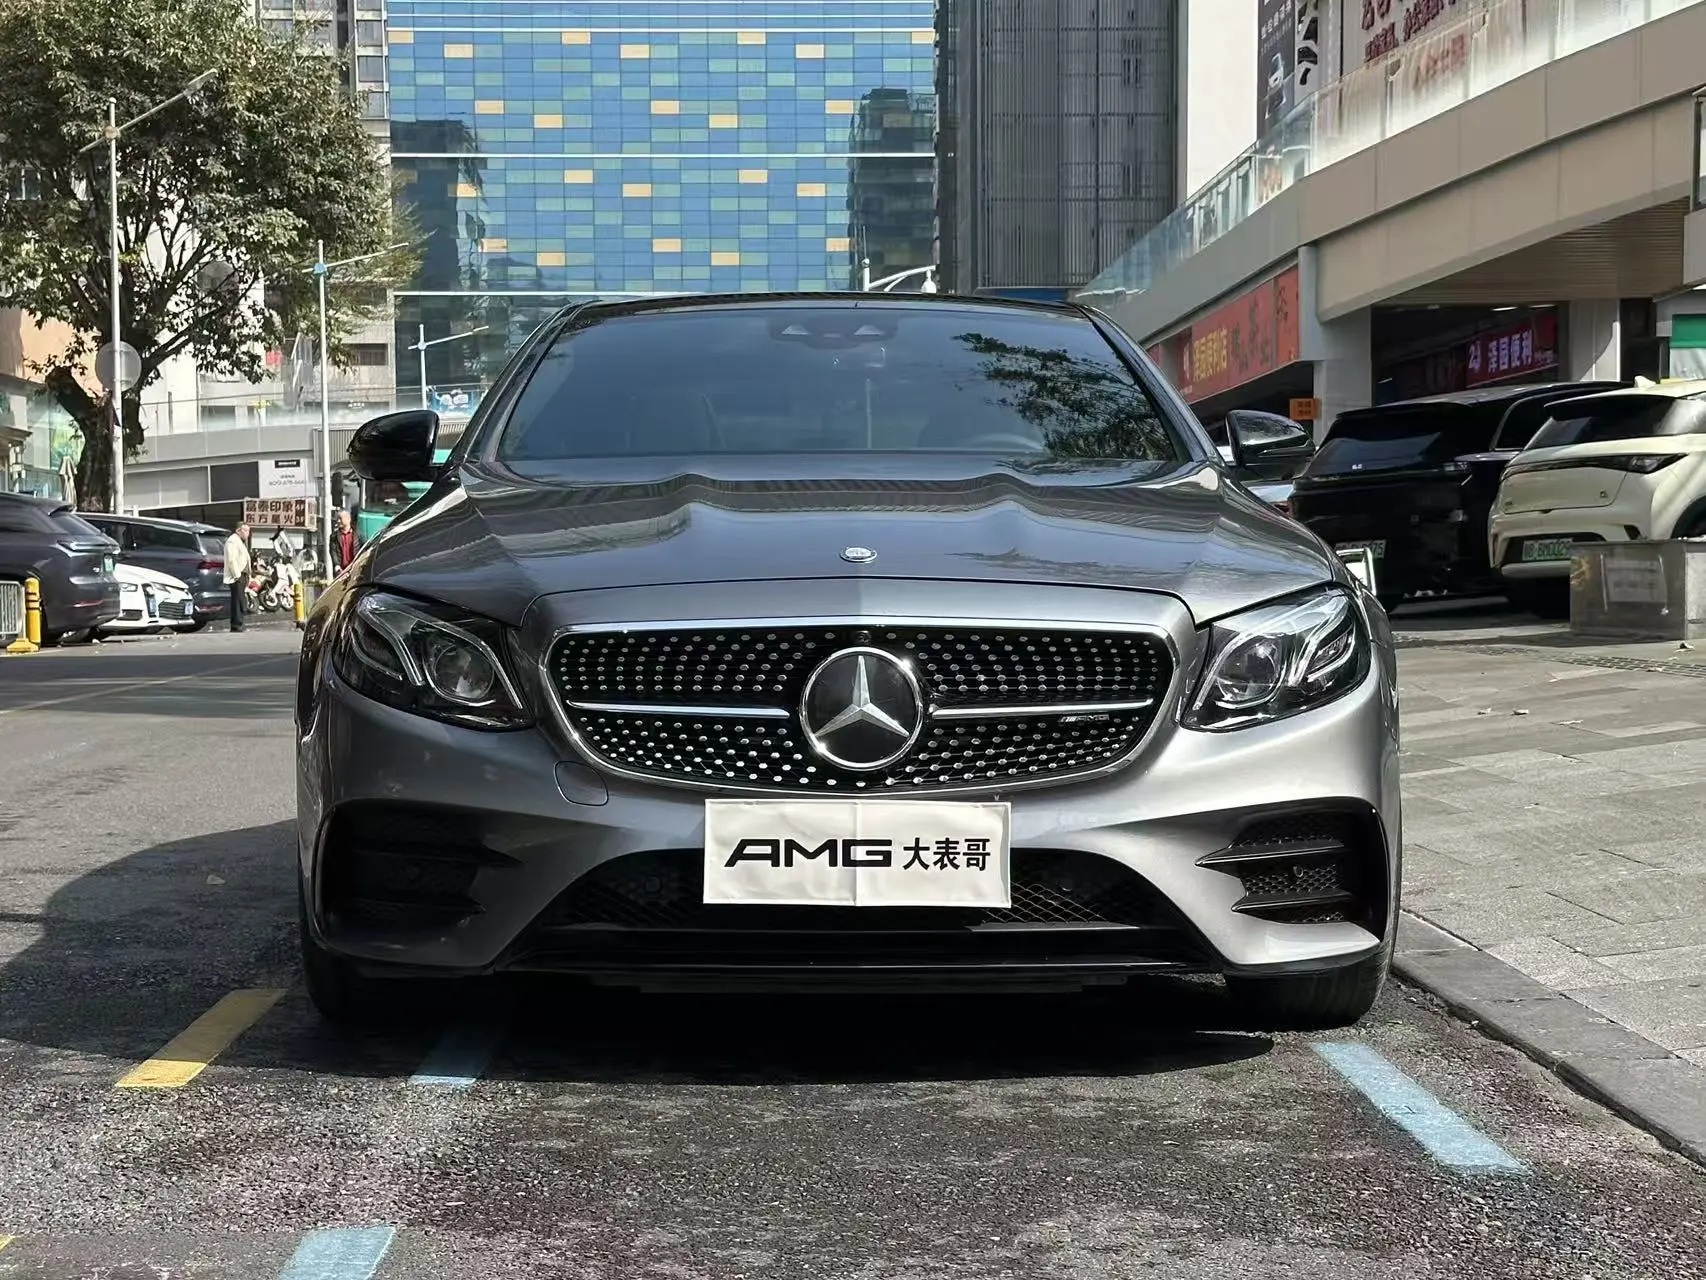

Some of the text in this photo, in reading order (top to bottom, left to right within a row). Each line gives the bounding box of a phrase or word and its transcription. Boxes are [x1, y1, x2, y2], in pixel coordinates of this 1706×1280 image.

[724, 837, 991, 871] AMG 大表哥
